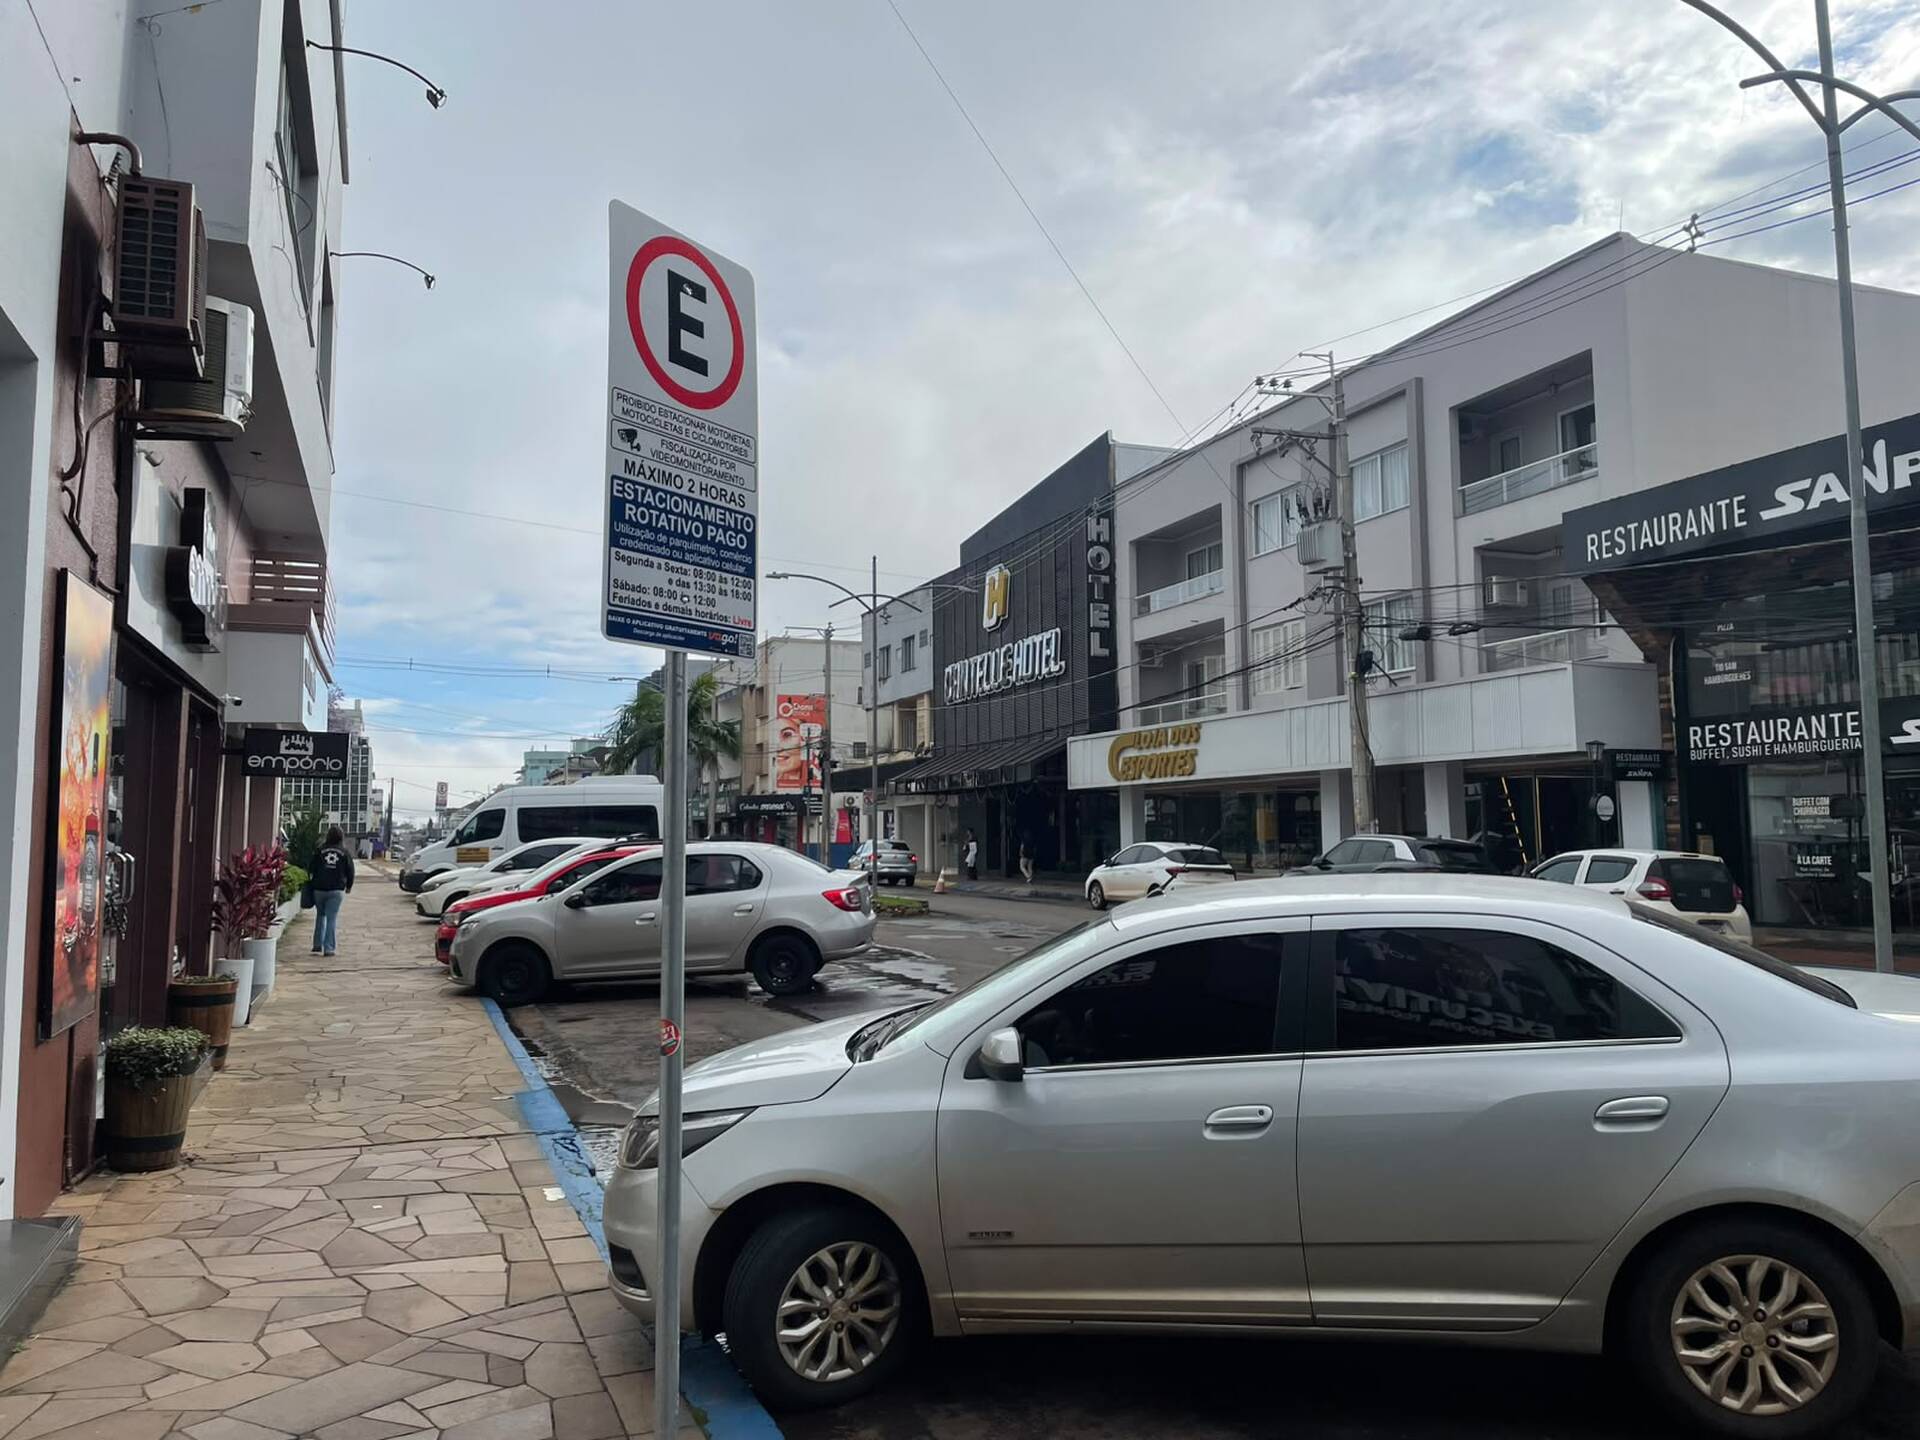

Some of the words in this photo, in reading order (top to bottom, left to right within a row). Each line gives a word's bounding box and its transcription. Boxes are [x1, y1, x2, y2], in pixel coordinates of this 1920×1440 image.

[667, 268, 708, 378] E
[616, 392, 656, 413] PROIBIDO
[658, 407, 707, 432] ESTACIONAR
[621, 407, 683, 435] MOTOCICLETAS
[685, 428, 690, 437] E
[692, 430, 748, 458] CICLOMOTORES
[650, 448, 745, 486] VIDEOMONITORAMENTO
[660, 438, 718, 466] FISCALIZAÇÃO
[719, 457, 737, 472] POR
[623, 458, 684, 490] MÁXIMO
[688, 478, 696, 494] 2
[700, 481, 746, 508] HORAS
[613, 479, 754, 533] ESTACIONAMENTO
[614, 521, 656, 541] Utilização
[657, 533, 668, 544] de
[720, 549, 753, 564] comércio
[624, 503, 703, 538] ROTATIVO
[707, 525, 747, 550] PAGO
[1587, 494, 1748, 562] RESTAURANTE
[614, 550, 654, 568] Segunda
[656, 561, 662, 570] a
[664, 561, 691, 577] Sexta:
[693, 567, 716, 583] 08:00
[718, 573, 728, 585] às
[730, 577, 752, 590] 12:00
[619, 536, 671, 556] credenciado
[672, 549, 683, 560] ou
[684, 551, 720, 569] aplicativo
[613, 578, 651, 595] Sábado:
[653, 586, 678, 601] 08:00
[693, 594, 717, 608] 12:00
[667, 577, 673, 586] e
[675, 577, 691, 589] das
[693, 580, 716, 595] 13:30
[718, 586, 728, 597] às
[1087, 516, 1111, 658] HOTEL
[612, 592, 652, 609] Feriados
[654, 601, 660, 610] e
[662, 602, 693, 617] demais
[695, 606, 731, 624] horários:
[732, 615, 752, 628] Livre
[1012, 628, 1065, 686] HOTEL
[1169, 722, 1202, 746] DOS
[1689, 711, 1861, 749] RESTAURANTE
[247, 755, 343, 775] empório
[1119, 748, 1199, 781] ESPORTES
[1616, 753, 1660, 763] RESTAURANTE
[1690, 748, 1730, 761] BUFFET,
[1732, 745, 1763, 758] SUSHI
[1764, 744, 1771, 756] E
[1773, 738, 1863, 755] HAMBURGUERIA
[1802, 855, 1811, 865] LA
[1811, 855, 1832, 866] CARTE
